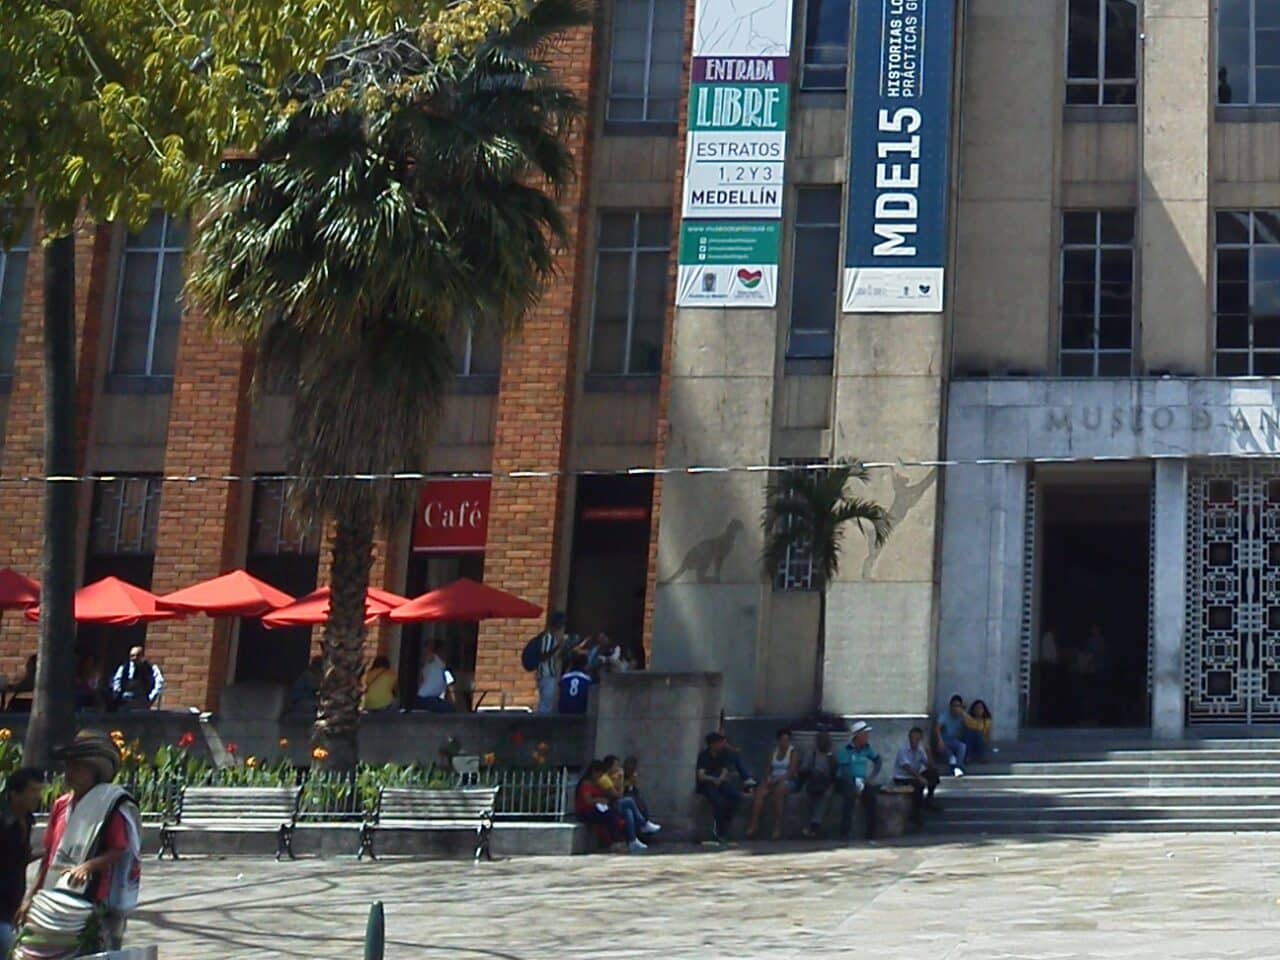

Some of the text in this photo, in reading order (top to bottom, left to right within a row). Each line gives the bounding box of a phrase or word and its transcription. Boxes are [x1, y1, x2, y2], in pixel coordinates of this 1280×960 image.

[888, 19, 903, 97] HISTORIAS
[901, 16, 918, 97] PRÁCTICAS
[705, 58, 775, 81] ENTRADA
[696, 87, 780, 127] LIBRE
[696, 142, 780, 157] ESTRATOS
[736, 166, 745, 181] 2
[749, 167, 759, 181] Y
[763, 167, 772, 181] 3
[873, 107, 922, 256] MDE15
[691, 187, 777, 205] MEDELLÍN
[424, 500, 482, 528] Café
[569, 678, 580, 696] 8
